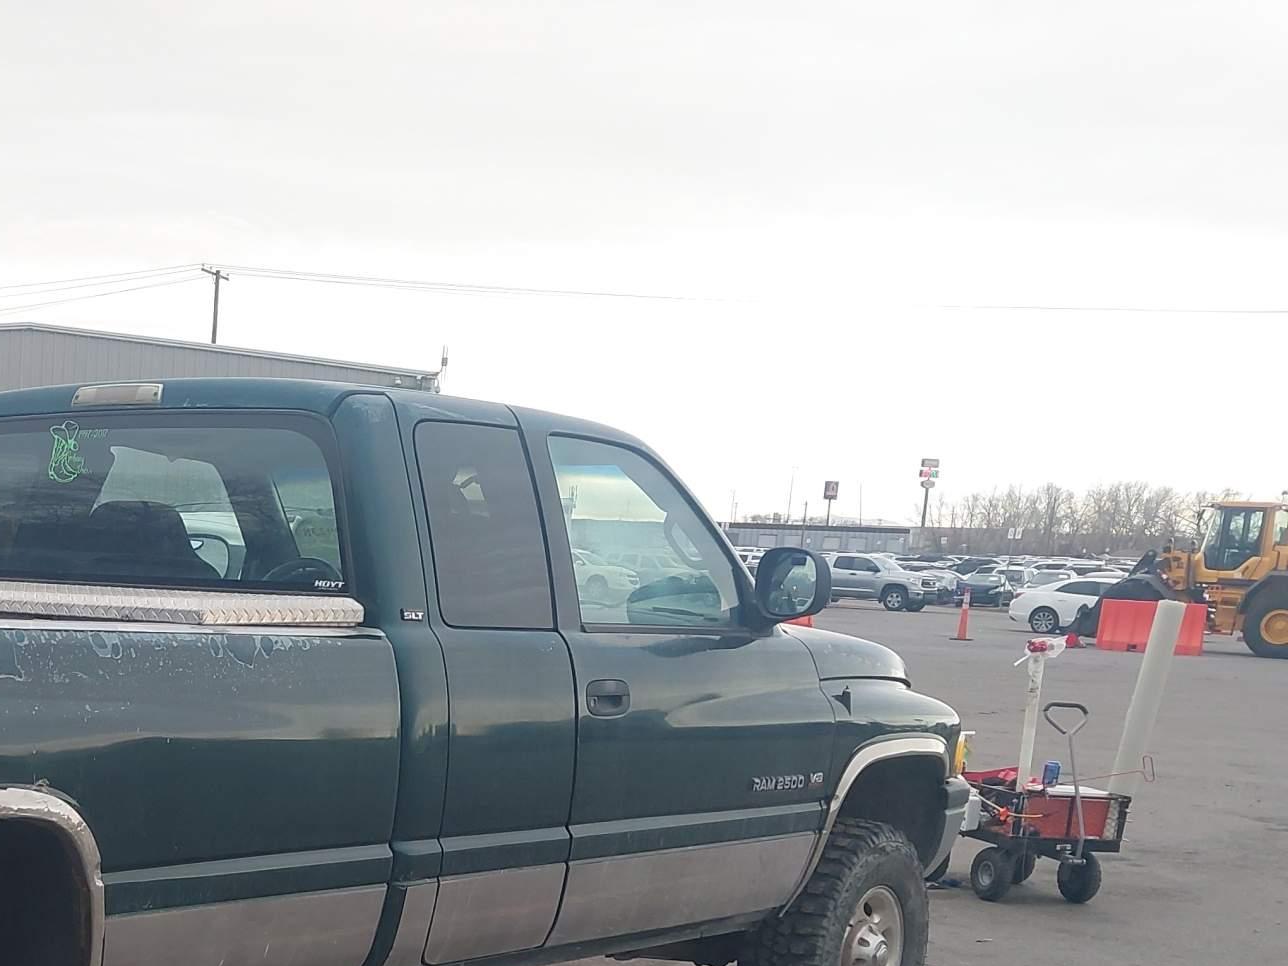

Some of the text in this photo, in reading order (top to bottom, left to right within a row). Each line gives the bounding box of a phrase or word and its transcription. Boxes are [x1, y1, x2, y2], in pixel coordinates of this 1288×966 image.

[314, 579, 345, 588] HOYT
[403, 611, 424, 620] SLT
[752, 772, 824, 792] RAM 2500 V8
